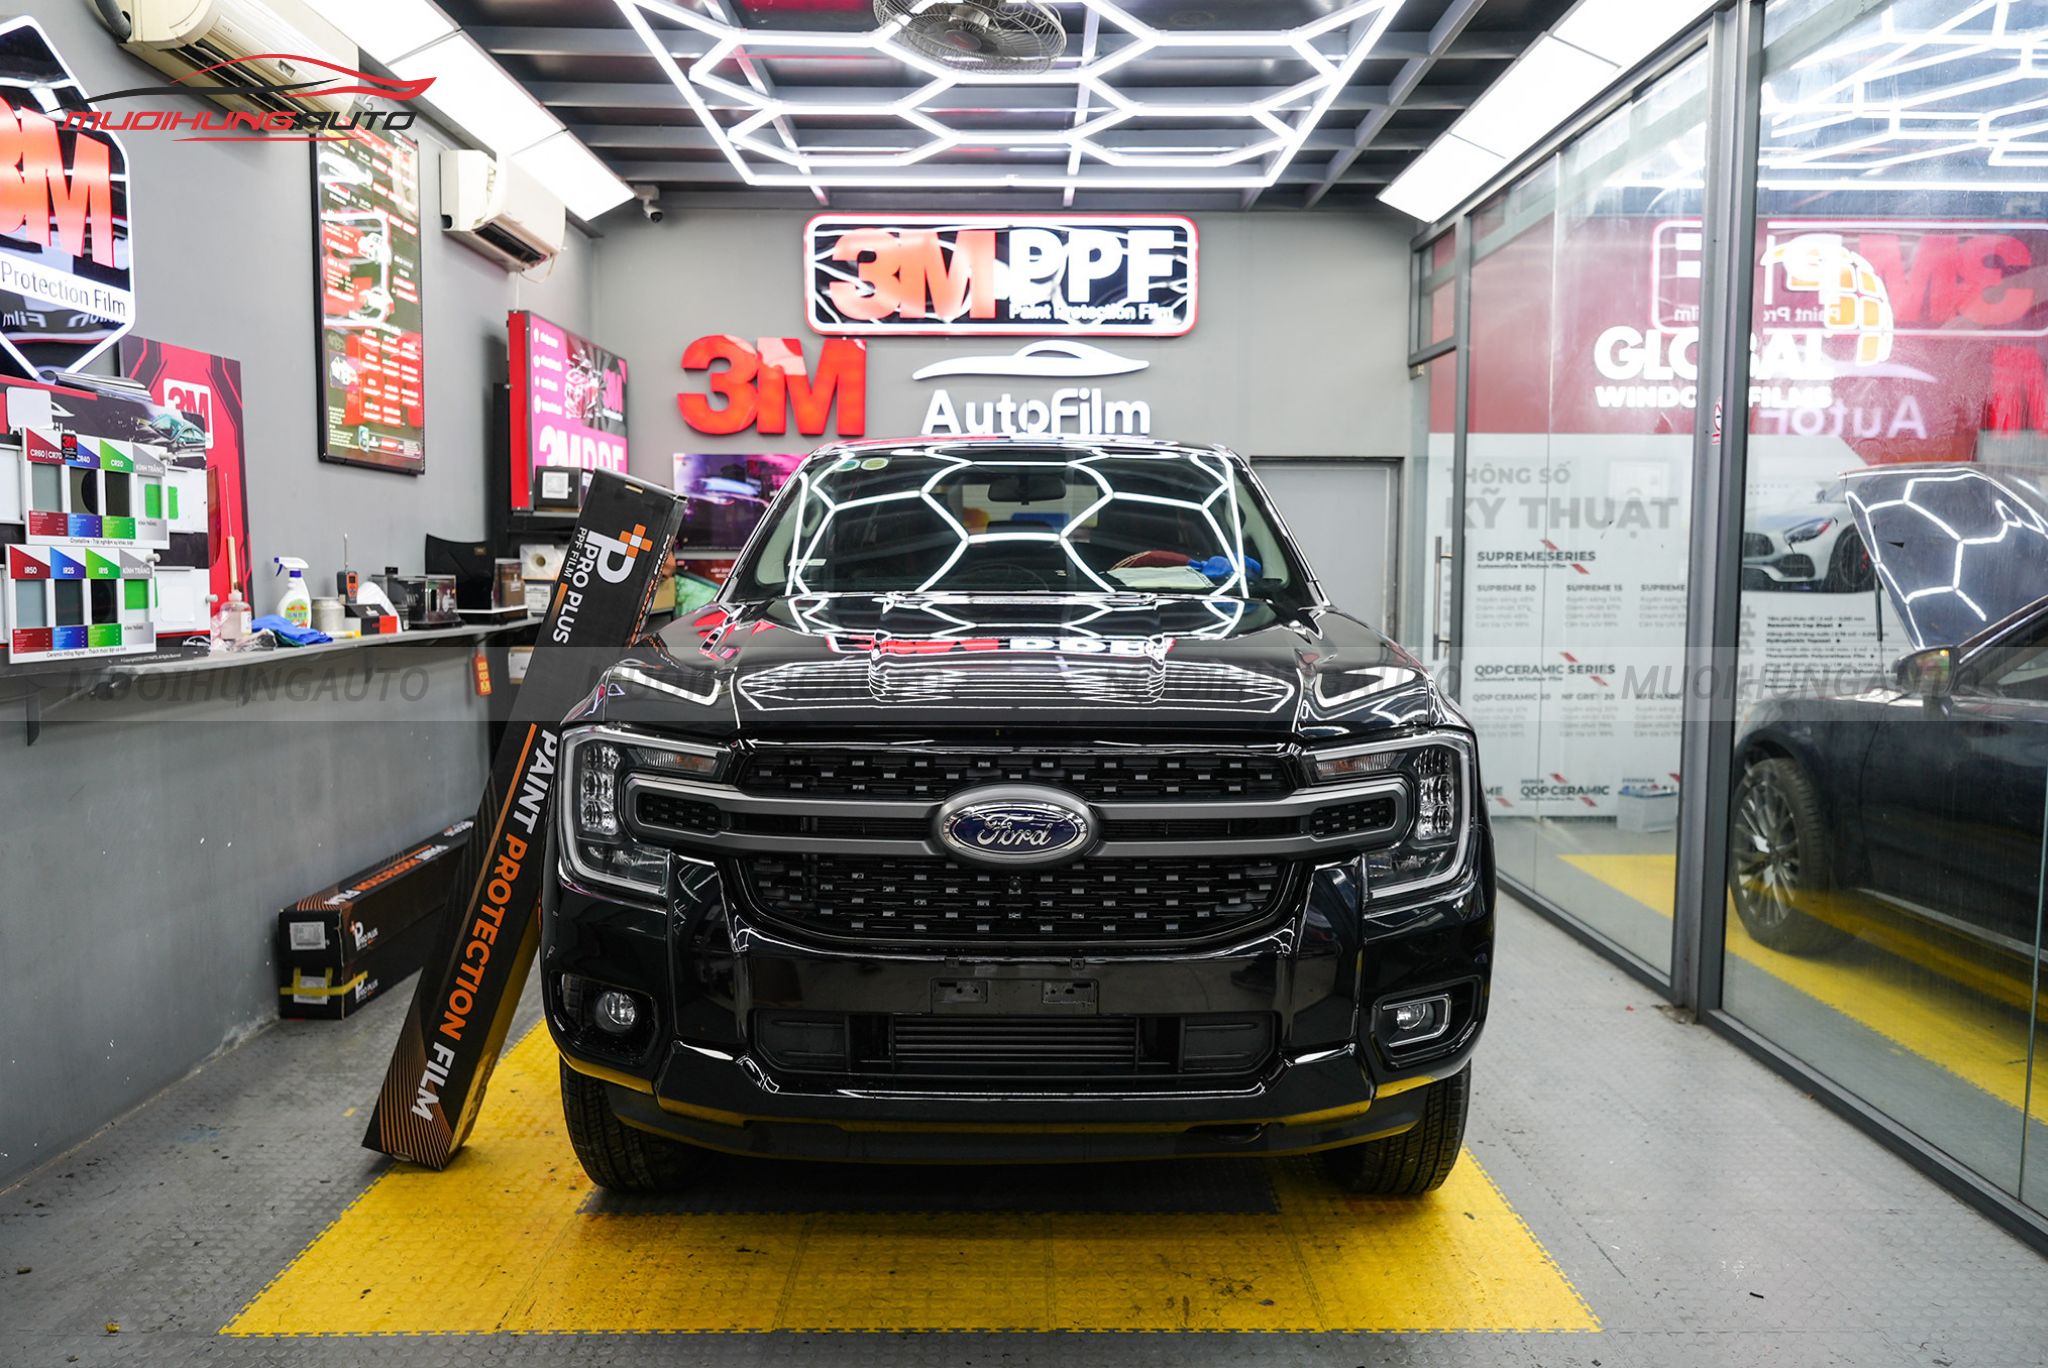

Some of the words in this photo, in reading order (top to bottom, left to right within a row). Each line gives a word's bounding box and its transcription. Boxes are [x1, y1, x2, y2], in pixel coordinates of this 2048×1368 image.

[1, 260, 89, 307] Protection
[94, 288, 127, 317] Film
[826, 228, 996, 320] 3M
[1008, 229, 1176, 303] PPF
[1009, 303, 1053, 320] Paint
[677, 335, 867, 436] 3M
[921, 388, 1151, 435] AutoFilm
[572, 526, 588, 550] PPF
[1519, 488, 1679, 539] THUẬT
[564, 550, 581, 578] FILM
[1477, 584, 1520, 592] SUPREME
[1566, 584, 1606, 592] SUPREME
[553, 590, 584, 644] PLUS
[1567, 664, 1616, 676] SERIES
[524, 728, 559, 834] PAINT
[976, 812, 1053, 846] Ford
[443, 830, 529, 1041] PROTECTION
[411, 1041, 456, 1125] FILM
